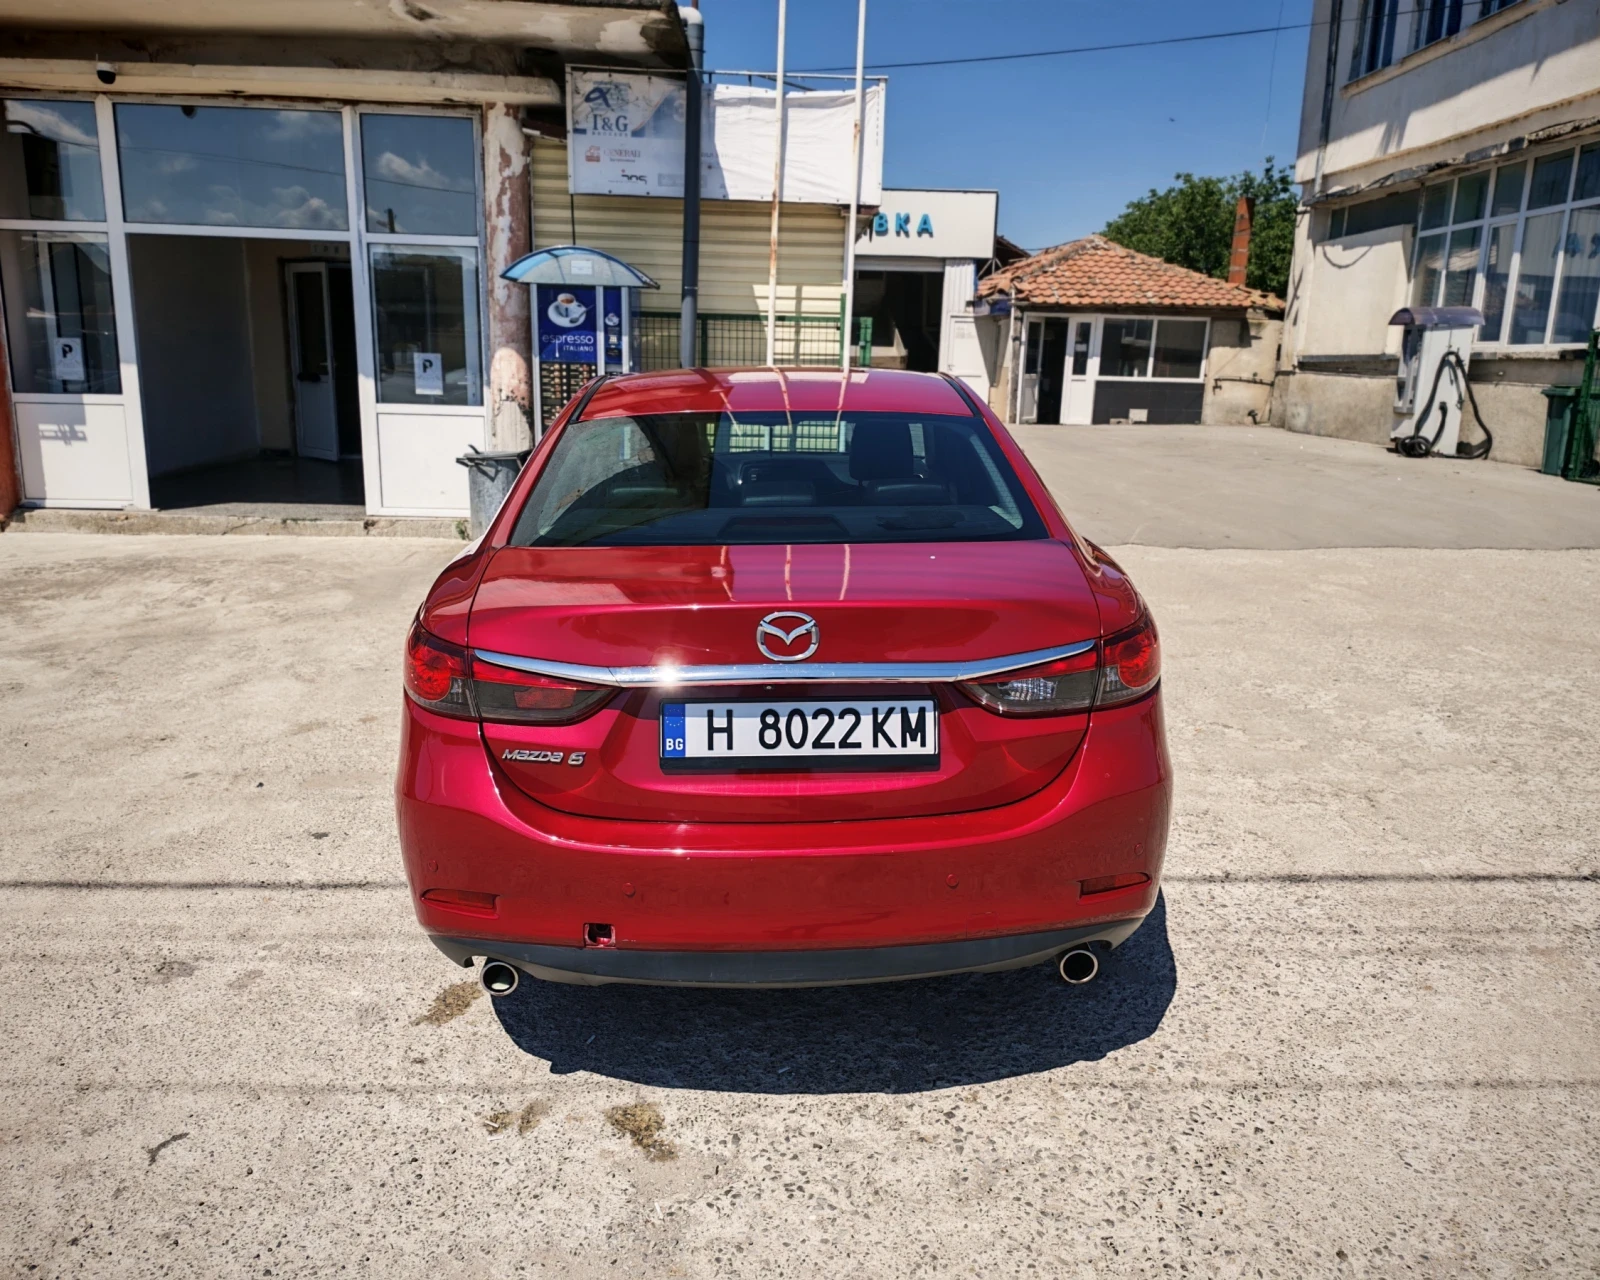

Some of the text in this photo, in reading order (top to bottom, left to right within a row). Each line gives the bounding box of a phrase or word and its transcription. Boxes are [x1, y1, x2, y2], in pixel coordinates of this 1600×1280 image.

[707, 706, 926, 750] H 8022 KM
[666, 738, 684, 750] BG
[568, 752, 586, 765] 6
